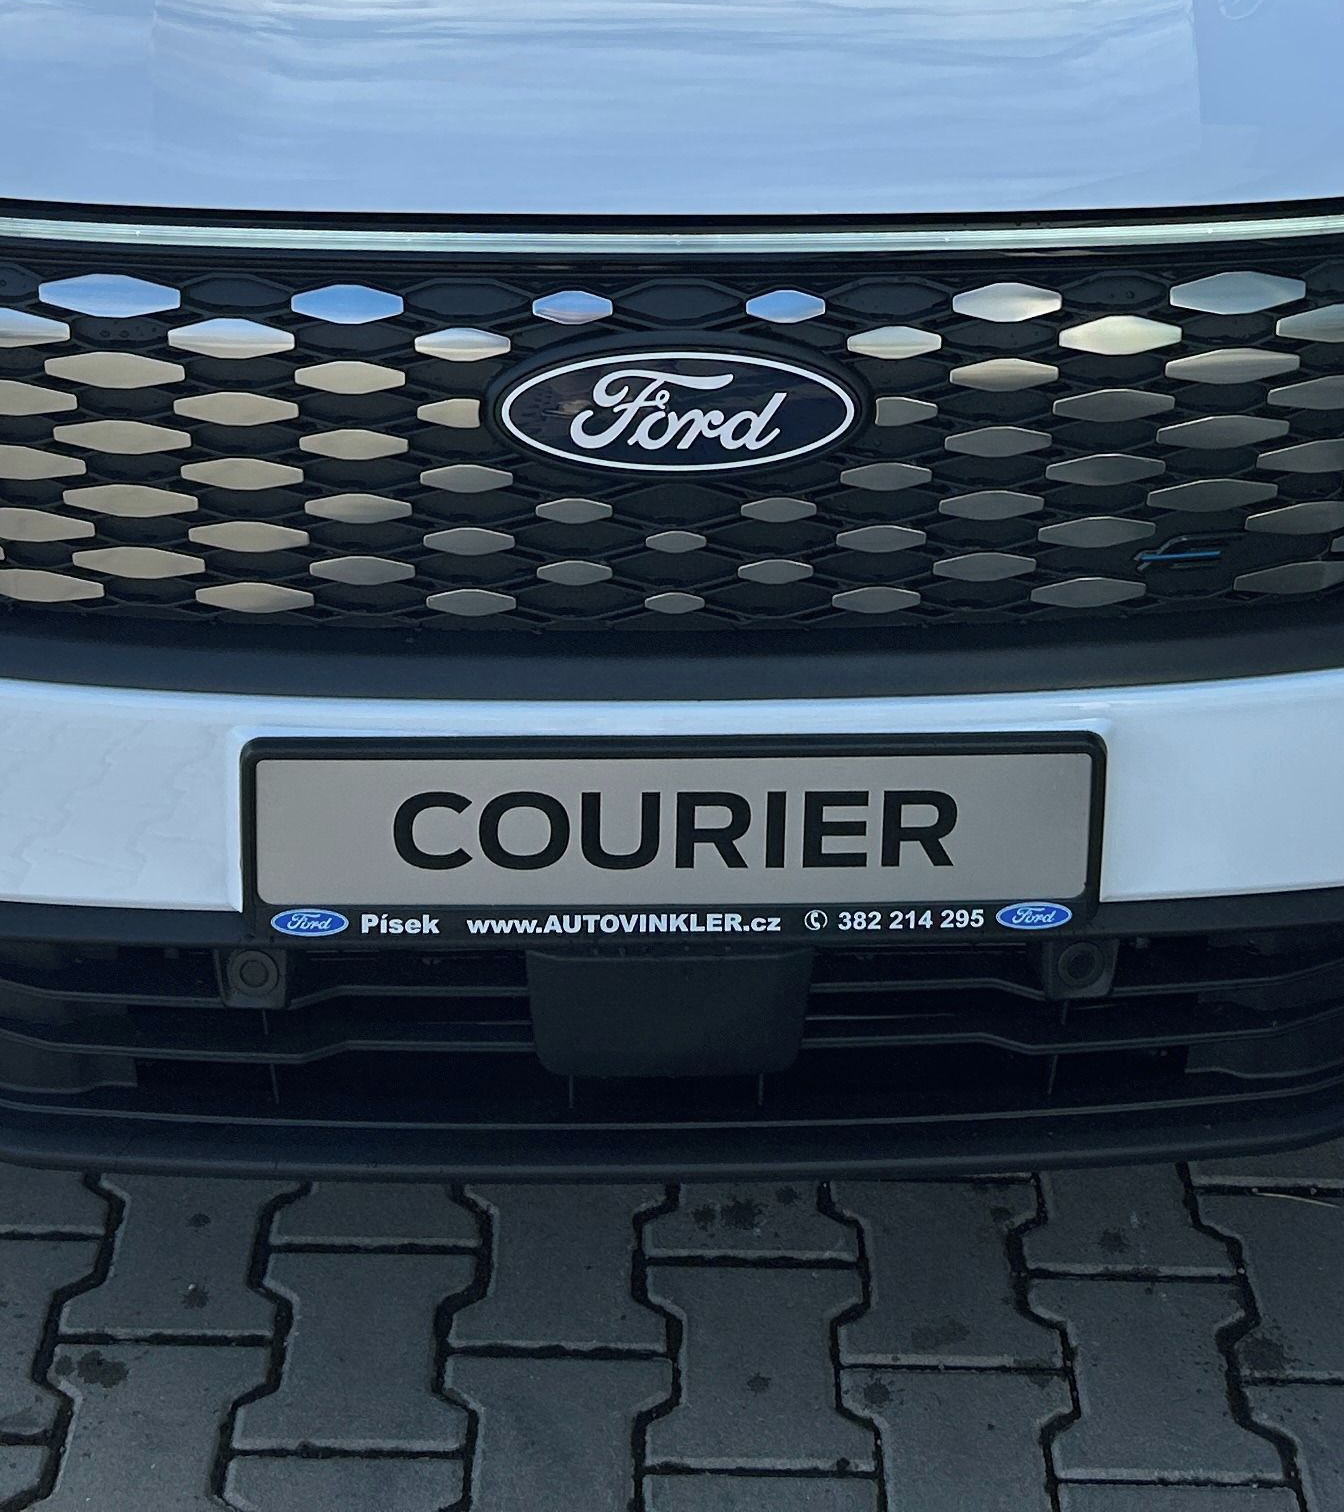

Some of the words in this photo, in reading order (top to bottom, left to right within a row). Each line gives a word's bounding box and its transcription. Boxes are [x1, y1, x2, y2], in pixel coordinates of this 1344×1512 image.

[570, 369, 787, 450] Ford
[393, 789, 959, 871] COURIER
[287, 912, 332, 930] Ford
[361, 913, 440, 934] Písek
[466, 913, 781, 934] www.AUTOVINKLER.cz
[838, 911, 881, 930] 382
[889, 910, 933, 929] 214
[940, 909, 984, 929] 295
[1011, 907, 1056, 924] Ford
